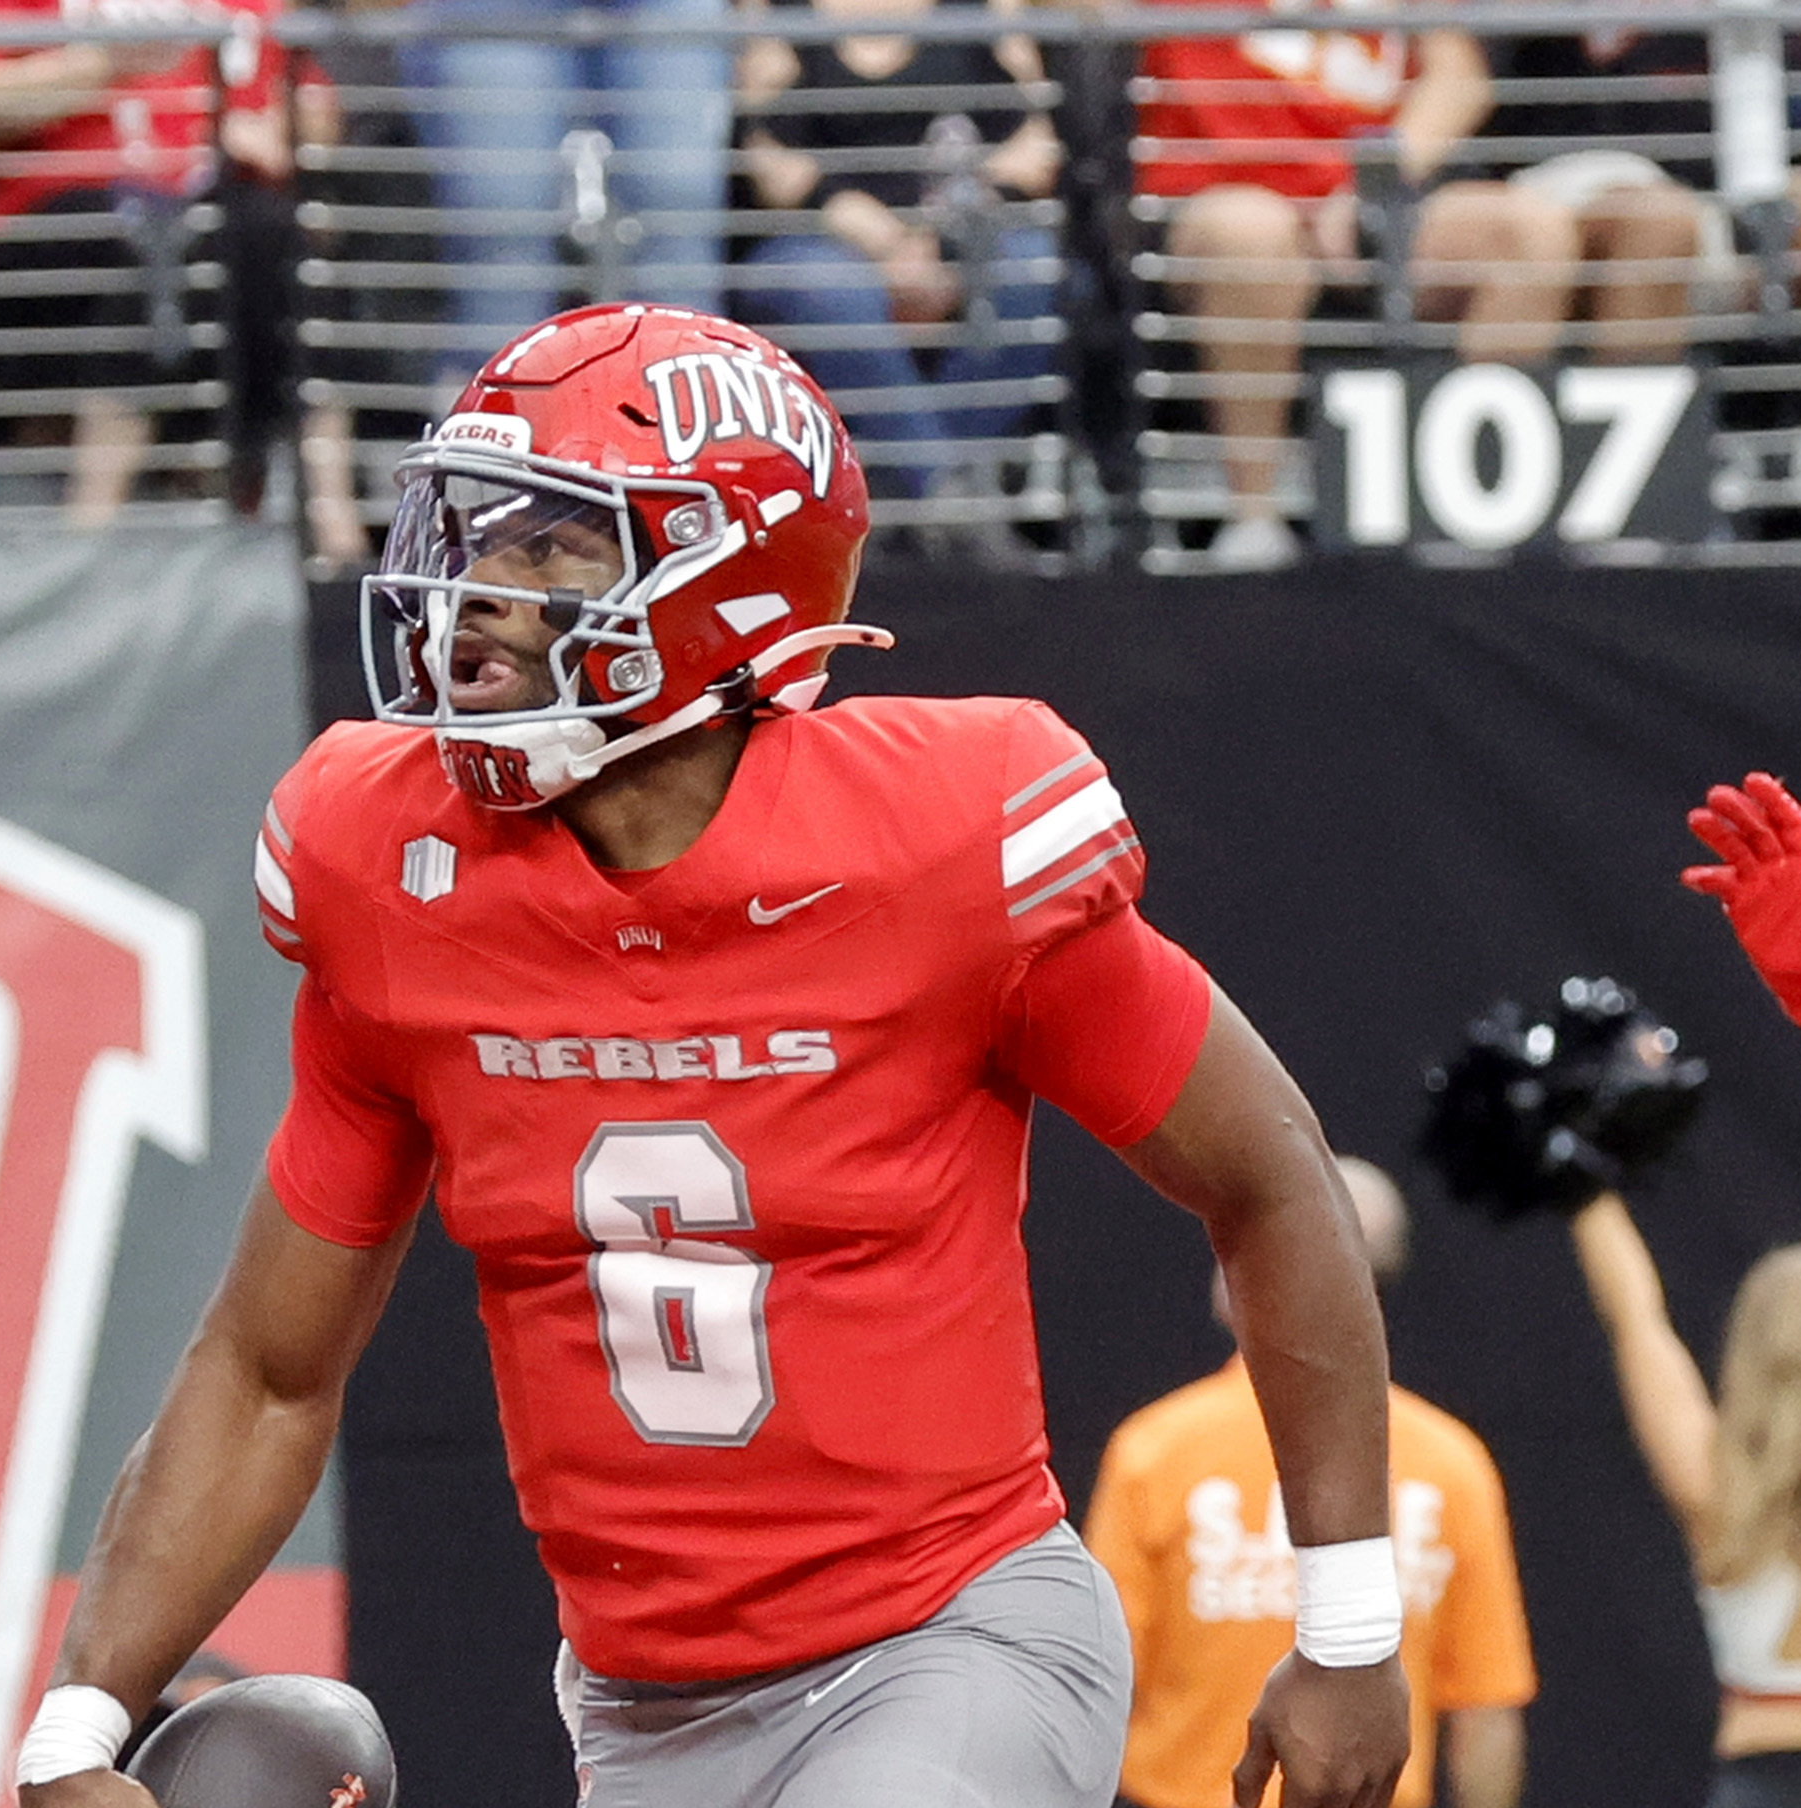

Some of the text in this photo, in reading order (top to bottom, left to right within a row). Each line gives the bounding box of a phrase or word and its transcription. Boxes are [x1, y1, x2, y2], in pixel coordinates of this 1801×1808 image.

[440, 424, 518, 449] VEGAS
[644, 353, 833, 500] UNLV
[1323, 366, 1696, 546] 107
[469, 1030, 837, 1080] REBELS
[574, 1120, 776, 1448] 6
